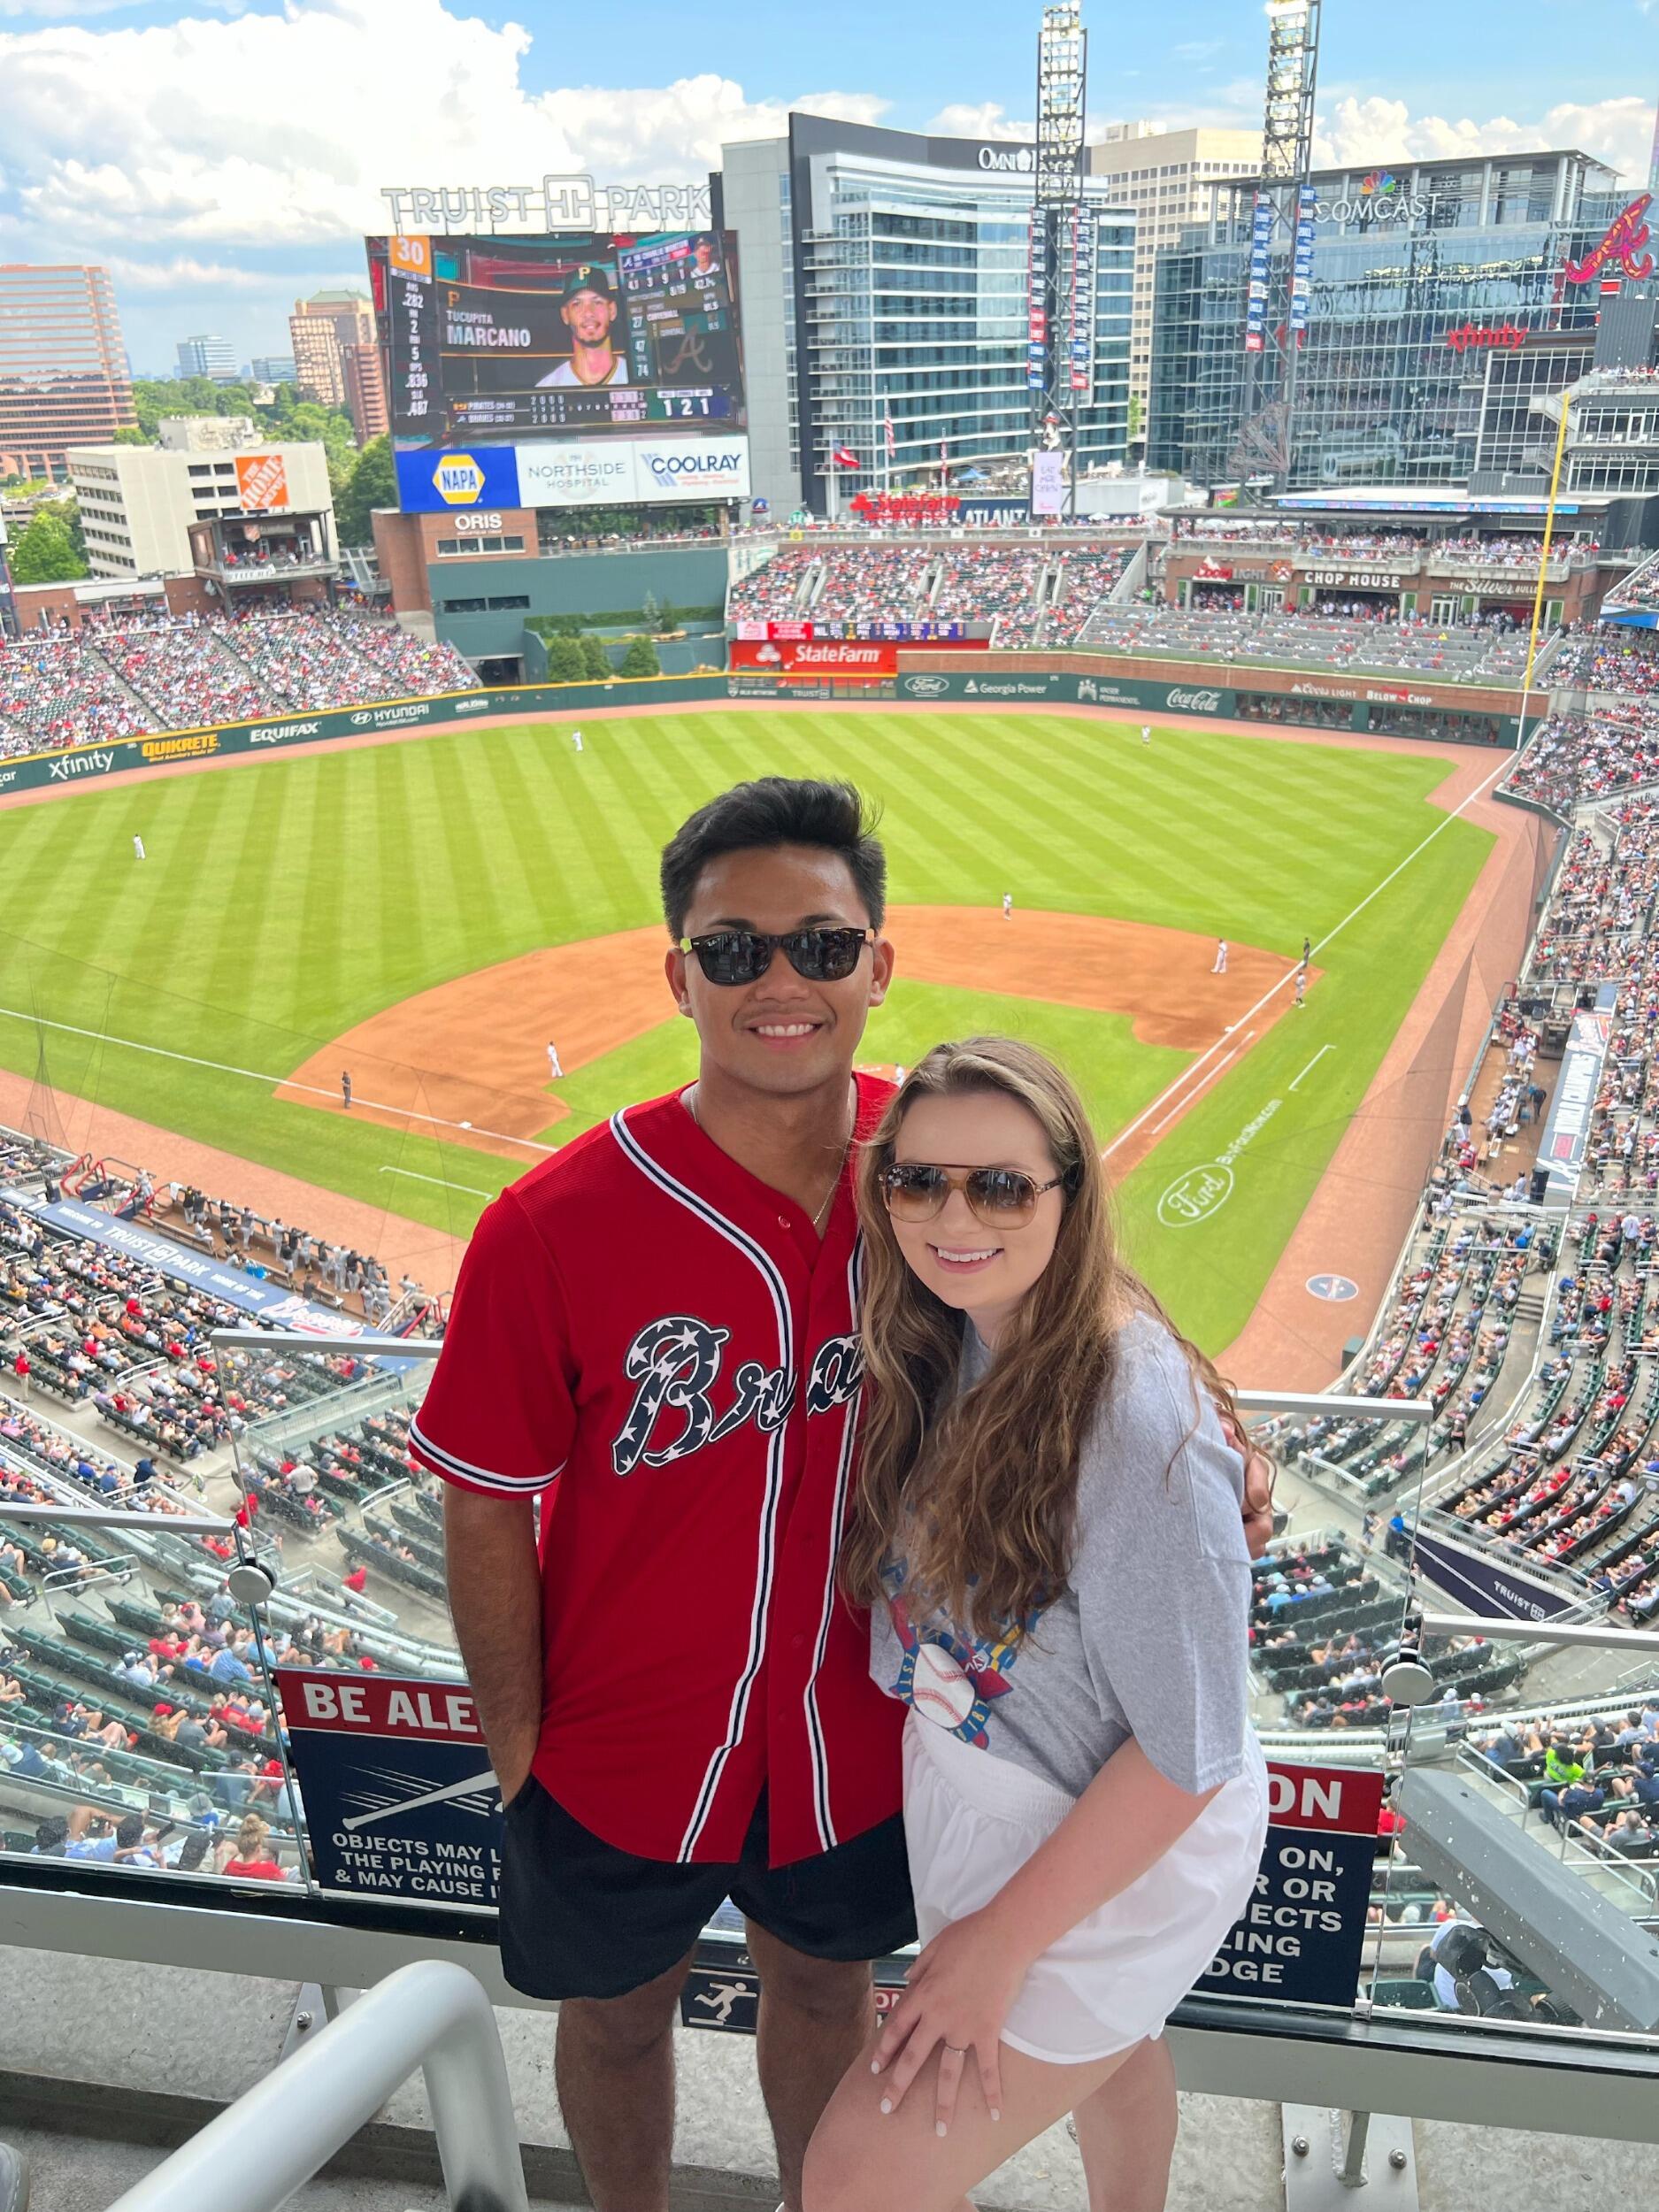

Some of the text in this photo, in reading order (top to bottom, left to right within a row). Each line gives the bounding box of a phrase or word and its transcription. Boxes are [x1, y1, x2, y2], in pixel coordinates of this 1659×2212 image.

[380, 184, 713, 224] TRUIST PARK
[1315, 193, 1442, 224] COMCAST
[396, 236, 425, 265] 30
[446, 310, 494, 325] TUCUPITA
[446, 325, 532, 347] MARCANO
[1447, 323, 1529, 353] xfinity
[664, 399, 672, 417] 1
[680, 398, 693, 416] 2
[700, 398, 710, 415] 1
[528, 463, 626, 478] NORTHSIDE
[651, 454, 742, 474] COOLRAY
[241, 456, 284, 510] HOME
[442, 469, 478, 490] NAPA
[547, 478, 610, 488] HOSPITAL
[454, 513, 503, 531] ORIS
[1304, 572, 1401, 588] CHOP HOUSE
[1449, 581, 1464, 590] THE
[1464, 577, 1514, 595] Silver
[795, 644, 879, 663] StateFarm
[910, 678, 943, 692] Ford
[979, 683, 1047, 695] Georgia Power
[1332, 689, 1357, 698] LIGHT
[1366, 689, 1397, 702] BELOW
[1408, 694, 1432, 705] CHOP
[373, 703, 430, 721] HYUNDAI
[250, 721, 319, 743] EQUIFAX
[142, 733, 218, 757] QUIKRETE
[49, 750, 114, 780] xfinity
[1167, 1171, 1225, 1218] Ford
[104, 1225, 157, 1252] TRUIST
[166, 1253, 211, 1277] PARK
[1494, 1580, 1531, 1611] TRUIST
[303, 1682, 371, 1724] BE
[332, 1832, 429, 1856] OBJECTS
[435, 1842, 483, 1862] MAY
[341, 1851, 384, 1870] THE
[390, 1855, 485, 1879] PLAYING
[1279, 1846, 1344, 1877] ON,
[334, 1870, 351, 1884] &
[358, 1871, 403, 1889] MAY
[411, 1876, 484, 1898] CAUSE
[1283, 1878, 1336, 1902] OR
